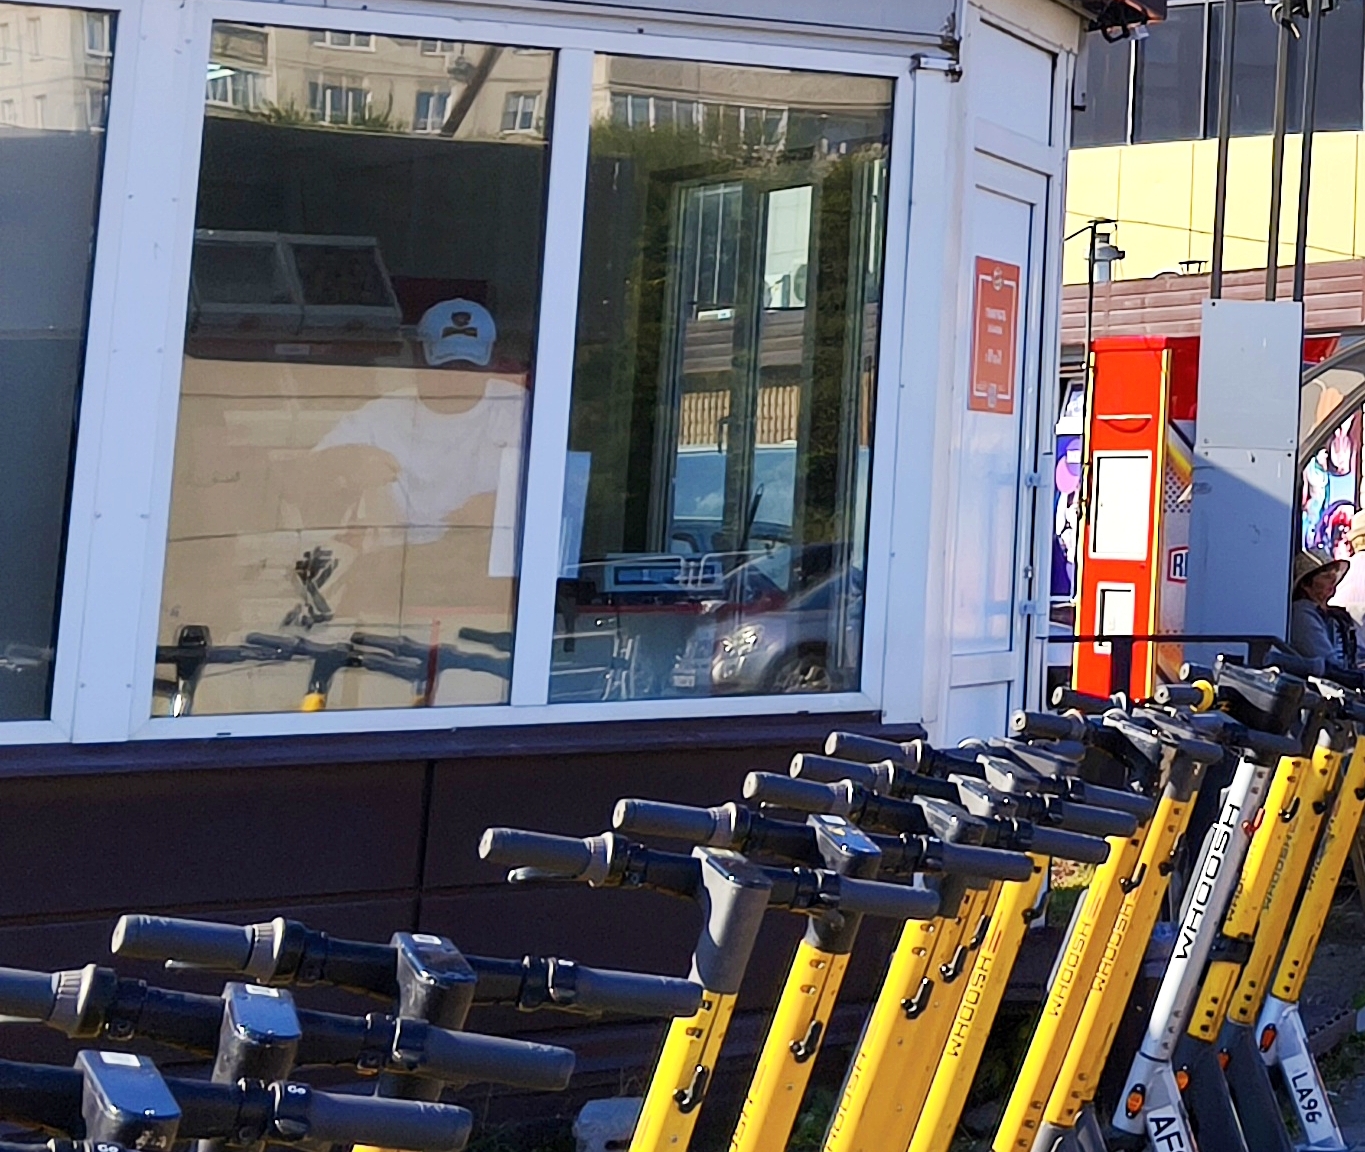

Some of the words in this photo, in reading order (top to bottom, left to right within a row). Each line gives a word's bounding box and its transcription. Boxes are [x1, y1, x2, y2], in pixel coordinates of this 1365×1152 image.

[1174, 803, 1241, 959] WHOOSH
[1048, 919, 1092, 1017] WHOOSH
[1092, 901, 1135, 992] WHOOSH
[946, 954, 993, 1057] WHOOSH
[1149, 1117, 1184, 1152] AF
[1291, 1071, 1322, 1125] LA96
